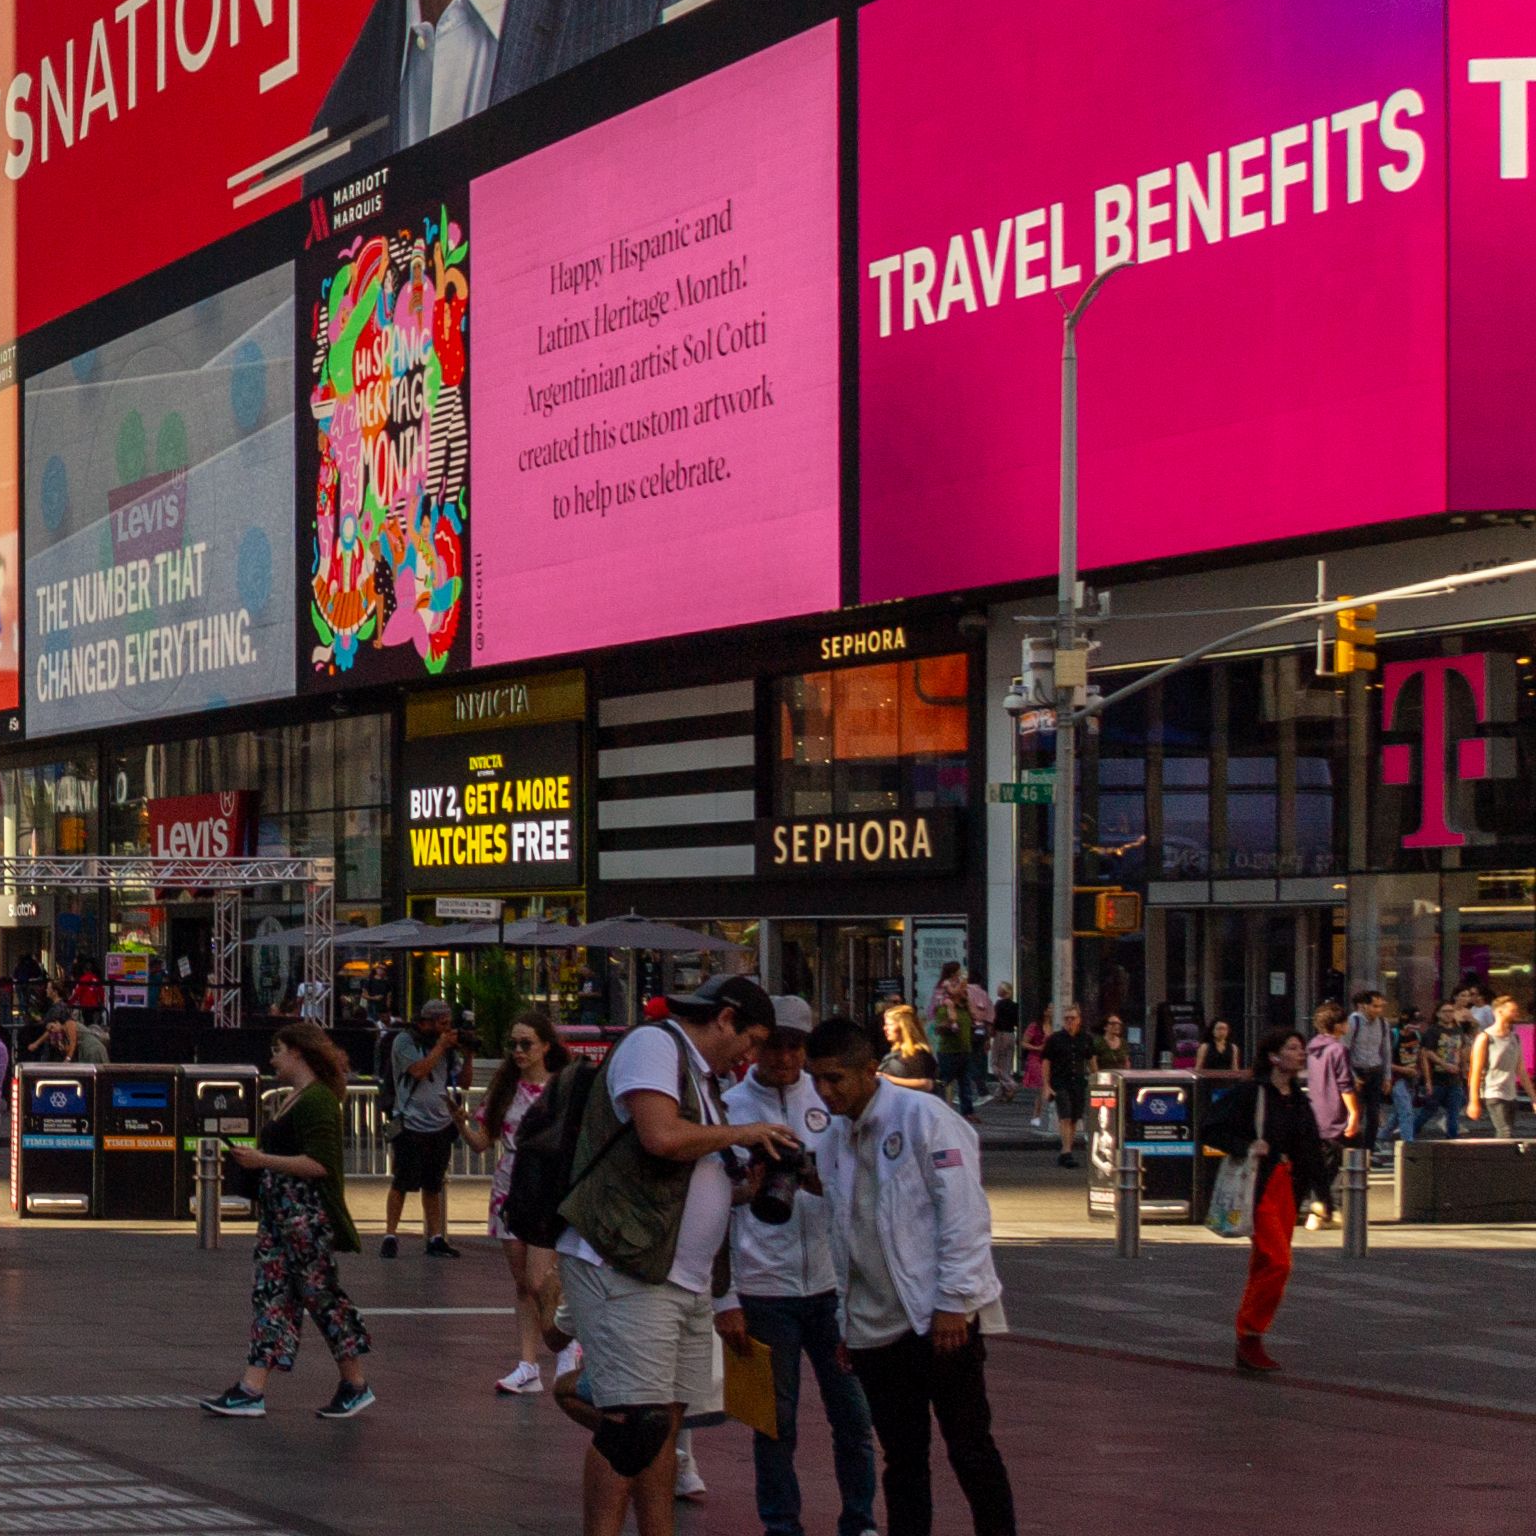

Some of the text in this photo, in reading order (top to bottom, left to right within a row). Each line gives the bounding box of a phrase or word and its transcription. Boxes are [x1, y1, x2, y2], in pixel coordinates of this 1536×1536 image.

[333, 168, 389, 208] MARRIOTT
[333, 194, 382, 230] MARQUIS
[869, 88, 1425, 337] TRAVEL BENEFITS
[550, 199, 733, 295] Happy Hispanic and
[538, 255, 748, 355] Latinx Heritage Month!
[355, 325, 430, 386] HISPANIC
[525, 312, 767, 418] Argentinian artist Sol Cotti
[355, 367, 433, 428] HERITAGE
[518, 374, 774, 472] created this custom artwork
[358, 424, 430, 509] MONTH
[553, 455, 731, 520] to help us celebrate.
[36, 543, 207, 634] THE NUMBER THAT
[36, 608, 257, 703] CHANGED EVERYTHING.
[821, 627, 906, 660] SEPHORA
[456, 685, 527, 721] INVICTA
[469, 754, 503, 770] INVICTA
[410, 776, 571, 822] BUY 2, GET 4 MORE
[410, 820, 571, 866] WATCHES FREE
[773, 817, 933, 864] SEPHORA
[106, 1138, 173, 1148] TIMES SQUARE
